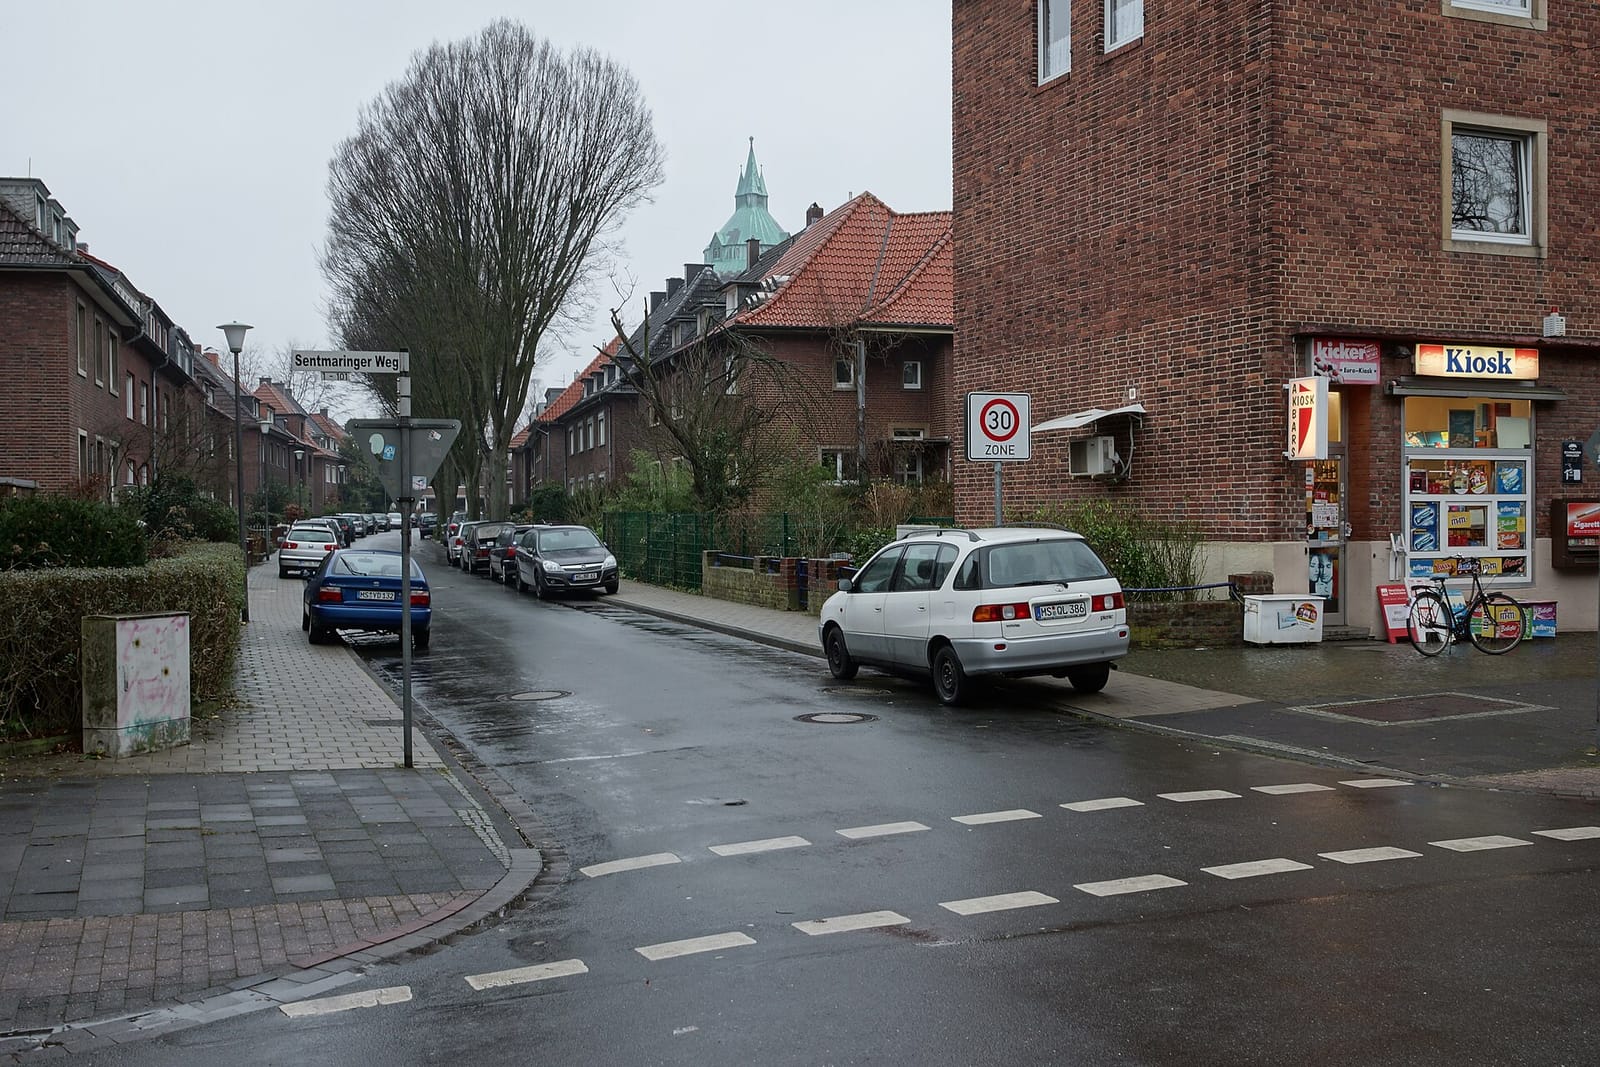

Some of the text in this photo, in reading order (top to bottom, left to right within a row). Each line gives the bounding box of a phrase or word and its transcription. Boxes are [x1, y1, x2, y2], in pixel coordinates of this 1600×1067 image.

[1317, 341, 1366, 360] kicker
[295, 353, 399, 371] Sentmaringer Weg
[1446, 348, 1513, 375] Kiosk
[1292, 394, 1315, 406] KIOSK
[988, 410, 1011, 430] 30
[985, 444, 1016, 456] ZONE
[1041, 606, 1052, 617] MS
[1069, 603, 1084, 614] 386
